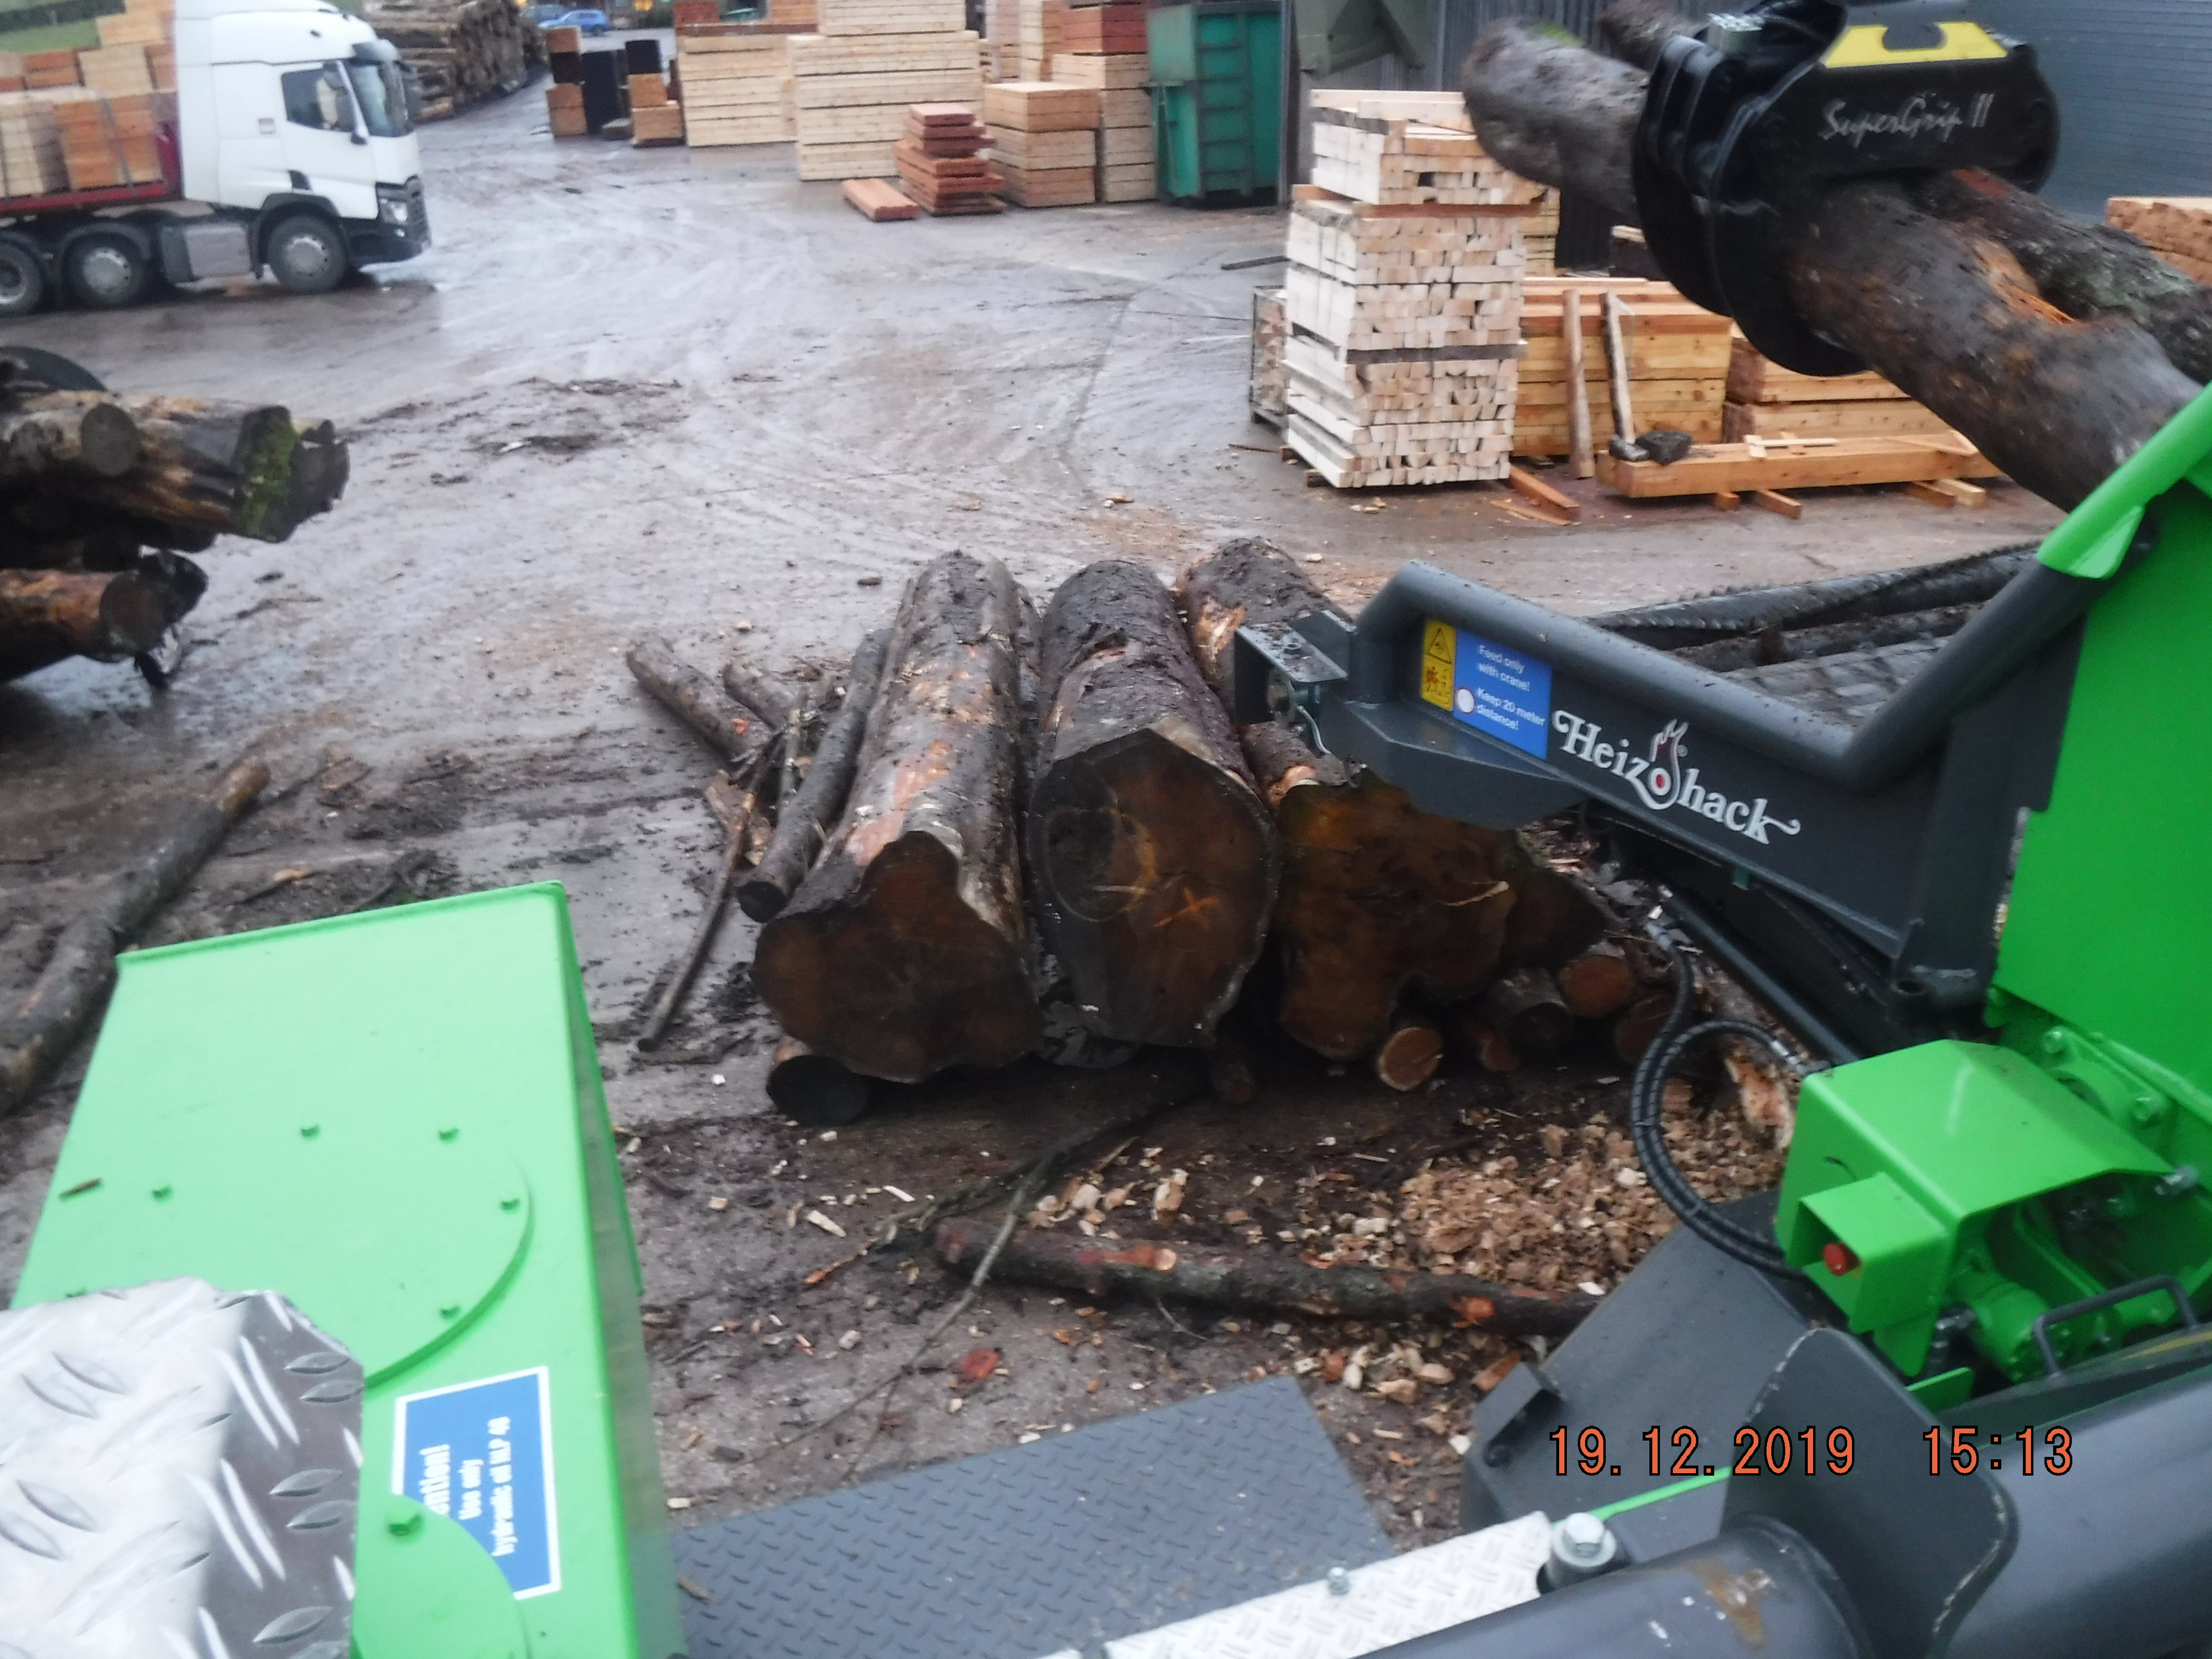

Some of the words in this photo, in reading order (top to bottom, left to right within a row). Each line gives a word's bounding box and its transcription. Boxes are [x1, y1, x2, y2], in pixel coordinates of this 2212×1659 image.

[1479, 645, 1502, 663] Feed
[1504, 658, 1525, 674] only
[1478, 662, 1498, 678] with
[1501, 673, 1530, 692] crane!
[1477, 687, 1502, 707] Keep
[1503, 699, 1515, 713] 20
[1516, 708, 1546, 726] meter
[1477, 704, 1519, 731] distance!
[418, 1444, 450, 1516] ention!
